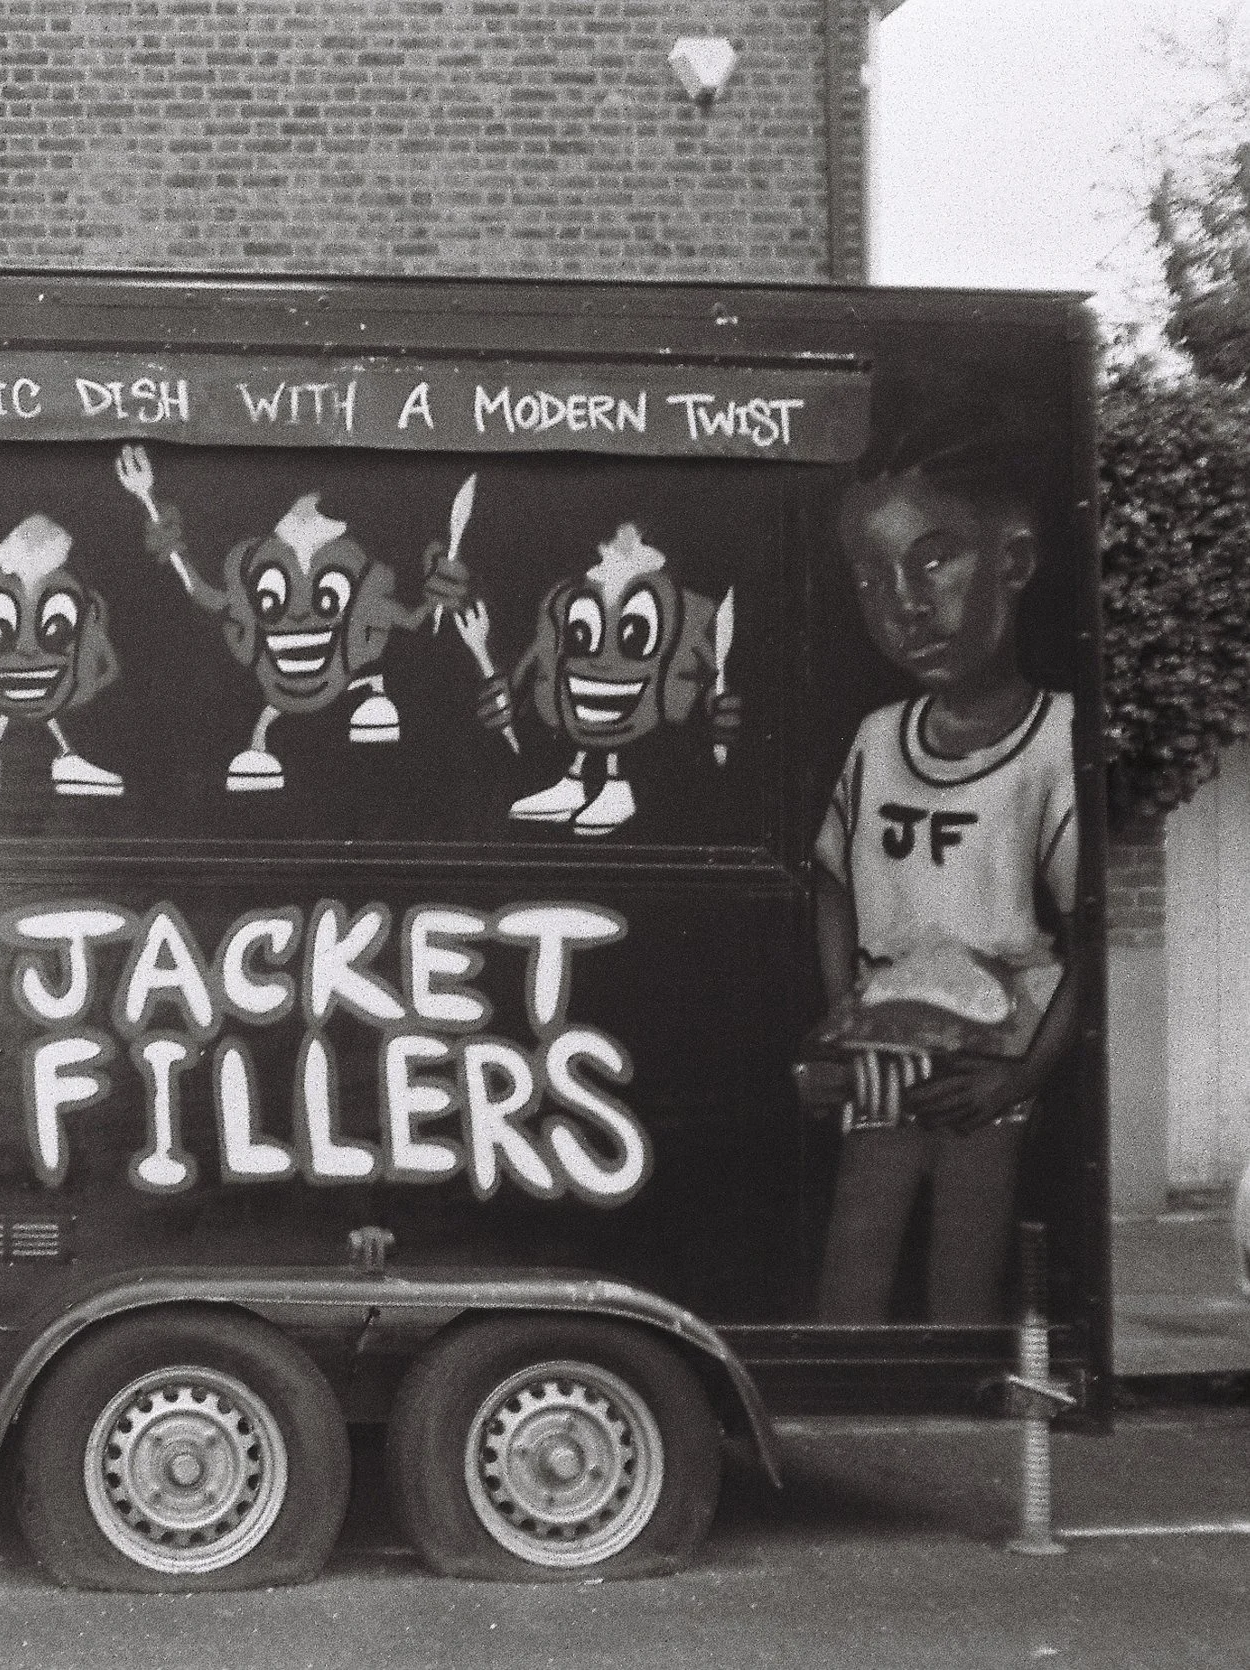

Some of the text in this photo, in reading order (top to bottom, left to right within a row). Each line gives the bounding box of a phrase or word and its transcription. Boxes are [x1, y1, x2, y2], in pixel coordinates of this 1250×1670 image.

[75, 377, 189, 424] DISH
[236, 381, 356, 433] WITH
[397, 381, 434, 430] A
[473, 385, 647, 434] MODERN
[667, 393, 805, 448] TWIST
[878, 802, 980, 867] JF
[0, 898, 626, 1034] JACKET
[28, 1030, 649, 1203] FILLERS
